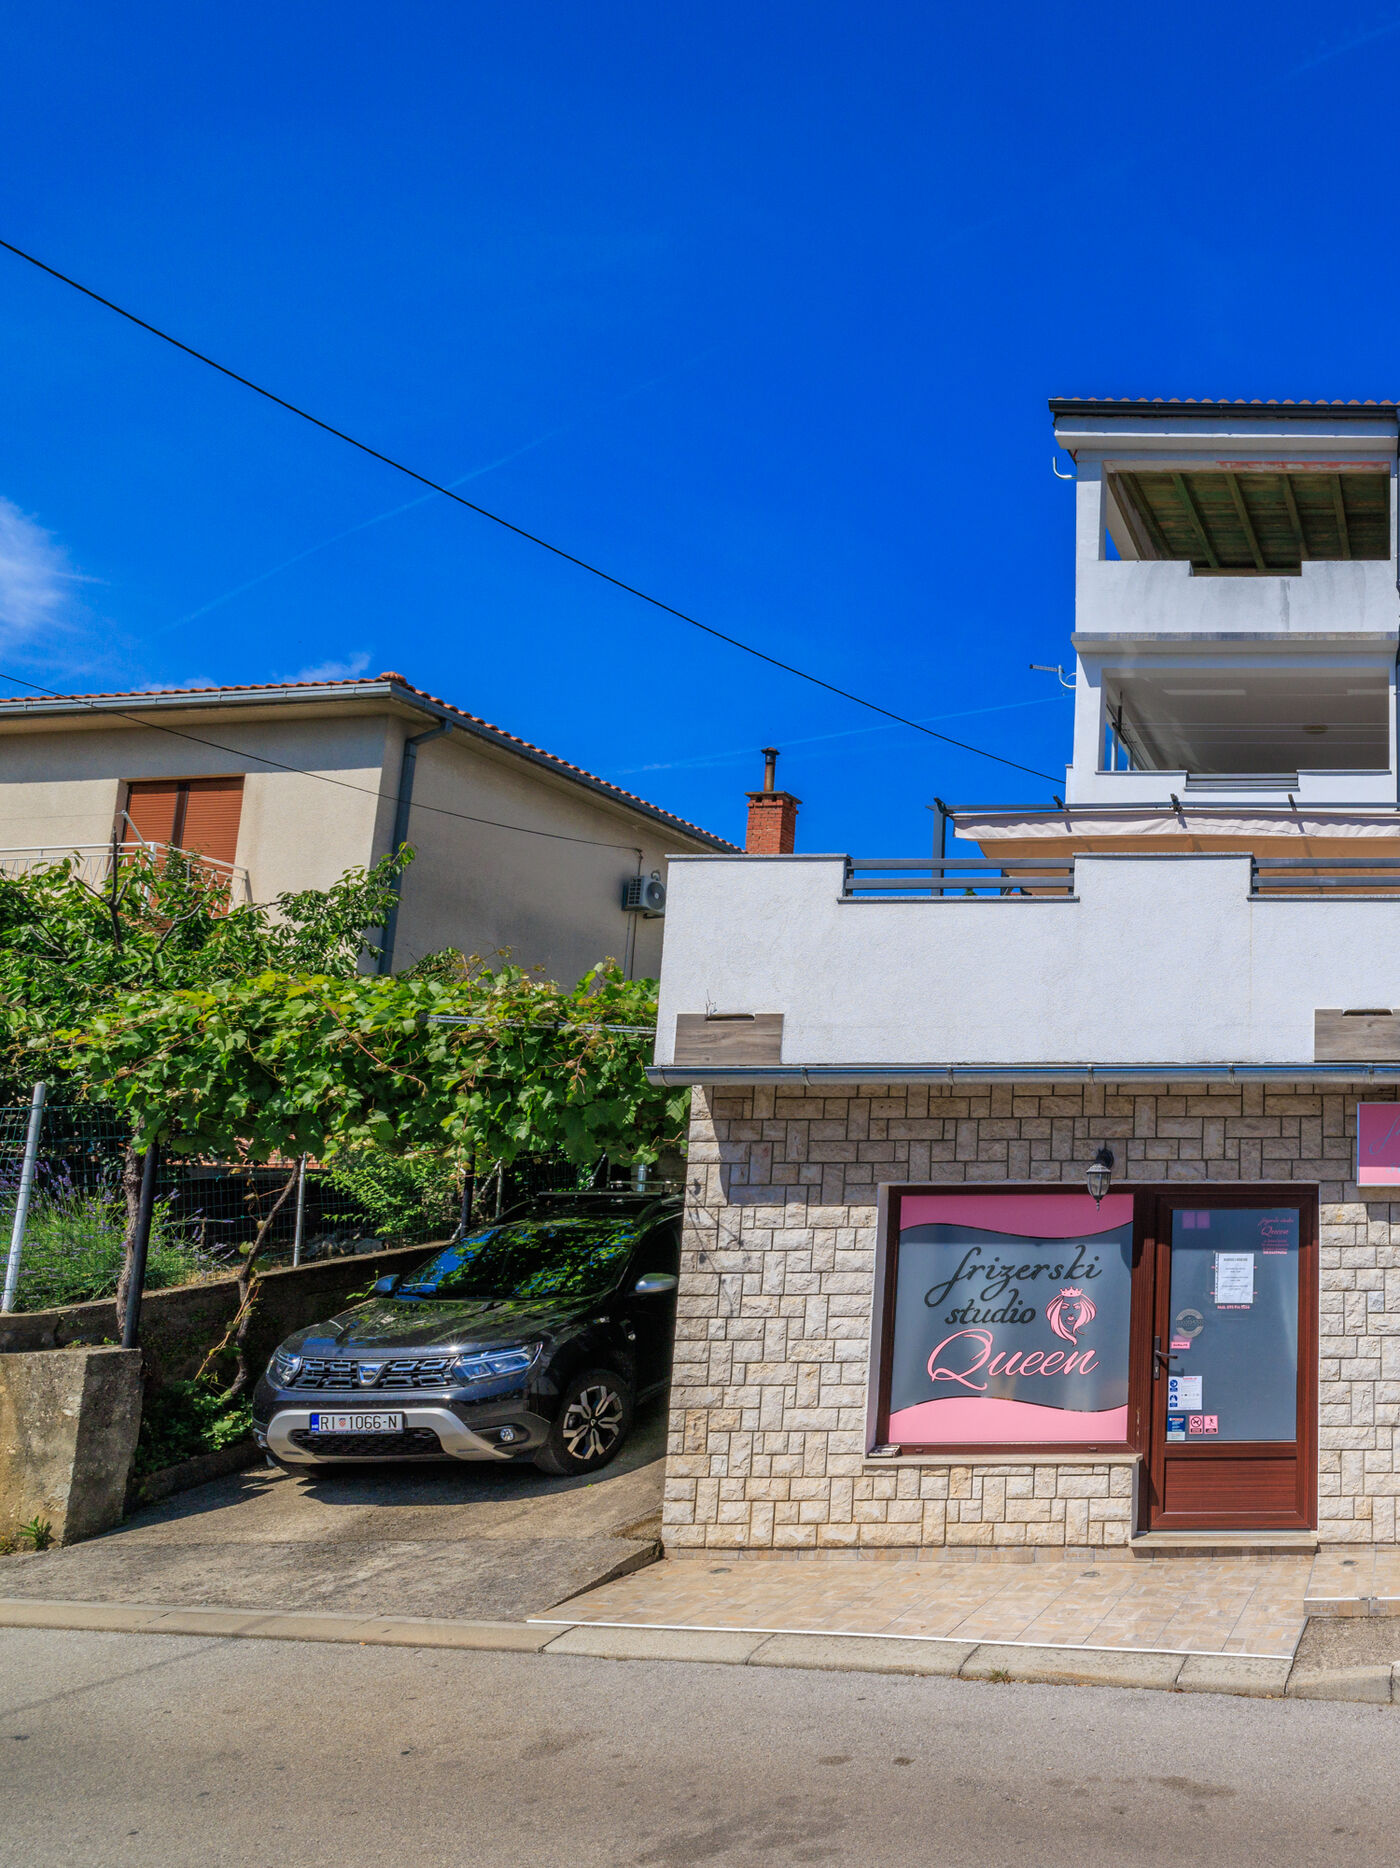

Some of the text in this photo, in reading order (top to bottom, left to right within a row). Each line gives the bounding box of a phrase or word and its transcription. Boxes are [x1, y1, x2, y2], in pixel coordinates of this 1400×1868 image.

[924, 1244, 1102, 1308] frizerski
[944, 1288, 1037, 1325] studio
[927, 1328, 1100, 1391] Queen
[320, 1416, 335, 1430] RI
